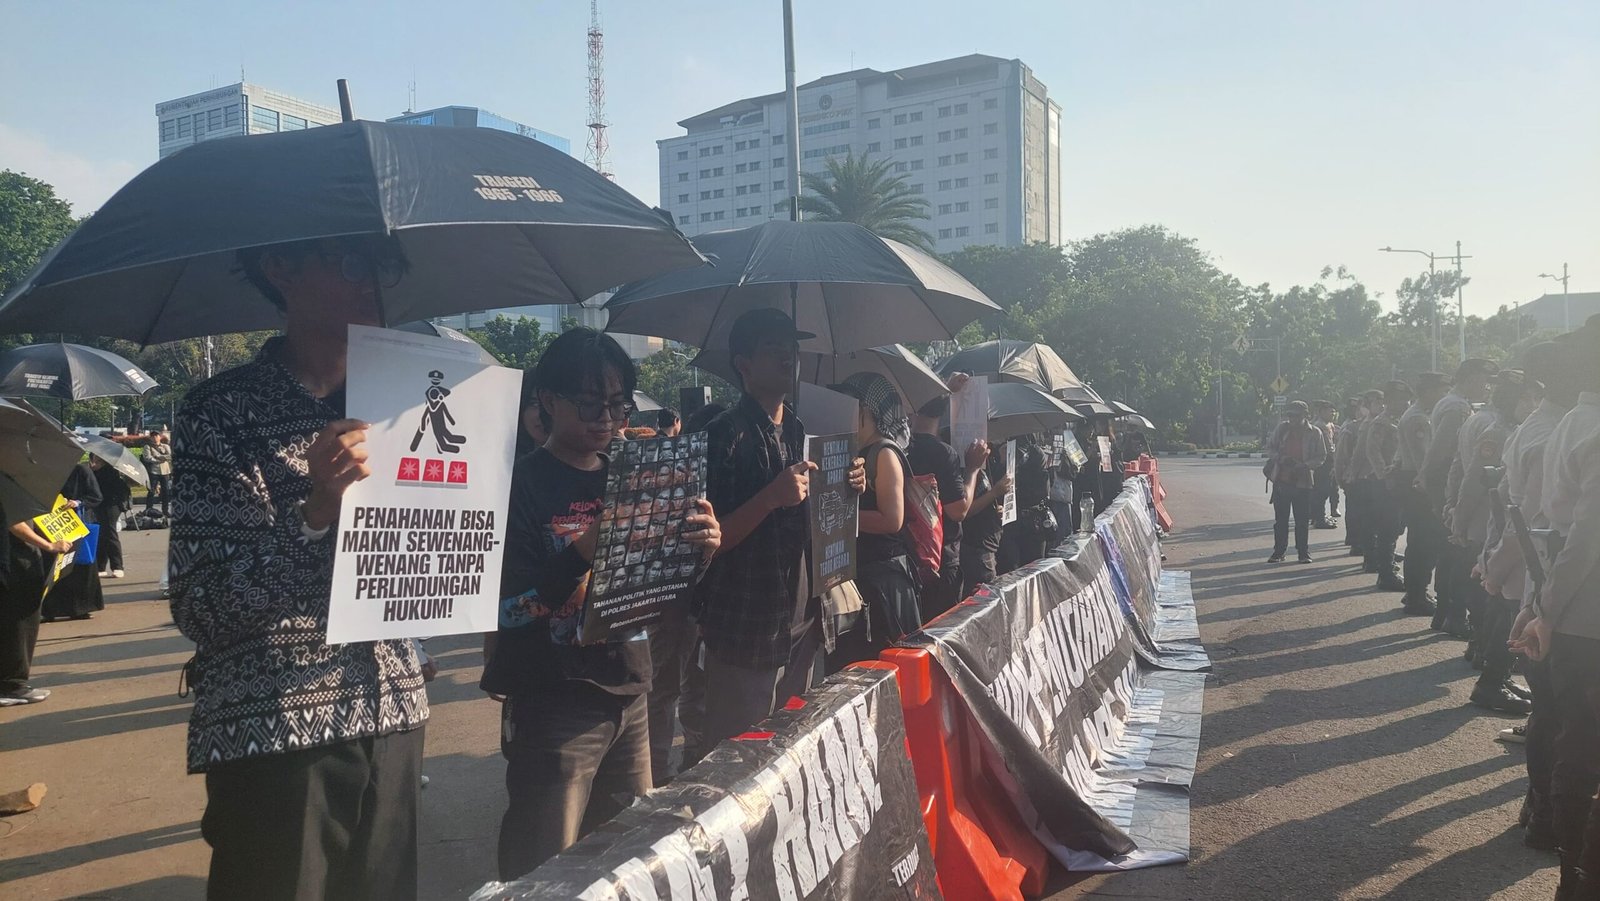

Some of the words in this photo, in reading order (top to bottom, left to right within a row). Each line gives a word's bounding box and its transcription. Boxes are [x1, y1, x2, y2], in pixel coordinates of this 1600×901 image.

[473, 175, 542, 189] TRAGEDI
[474, 187, 517, 201] 1965
[523, 189, 564, 203] 1966
[821, 453, 850, 472] KEKERASAN
[827, 468, 844, 486] APARAT
[46, 511, 74, 535] REVISI
[62, 520, 80, 536] POLRI
[353, 507, 456, 529] PENAHANAN
[460, 510, 495, 530] BISA
[342, 531, 401, 553] MAKIN
[406, 531, 500, 552] SEWENANG-
[356, 554, 431, 576] WENANG
[437, 554, 485, 574] TANPA
[819, 559, 833, 577] TEROR
[833, 551, 850, 570] NEGARA
[355, 576, 482, 600] PERLINDUNGAN
[593, 596, 622, 609] TAHANAN
[622, 590, 645, 602] POLITIK
[645, 586, 662, 596] YANG
[661, 582, 689, 593] DITAHAN
[383, 598, 454, 622] HUKUM!
[600, 610, 608, 618] DI
[607, 603, 631, 616] POLRES
[631, 597, 656, 609] JAKARTA
[656, 593, 676, 603] UTARA
